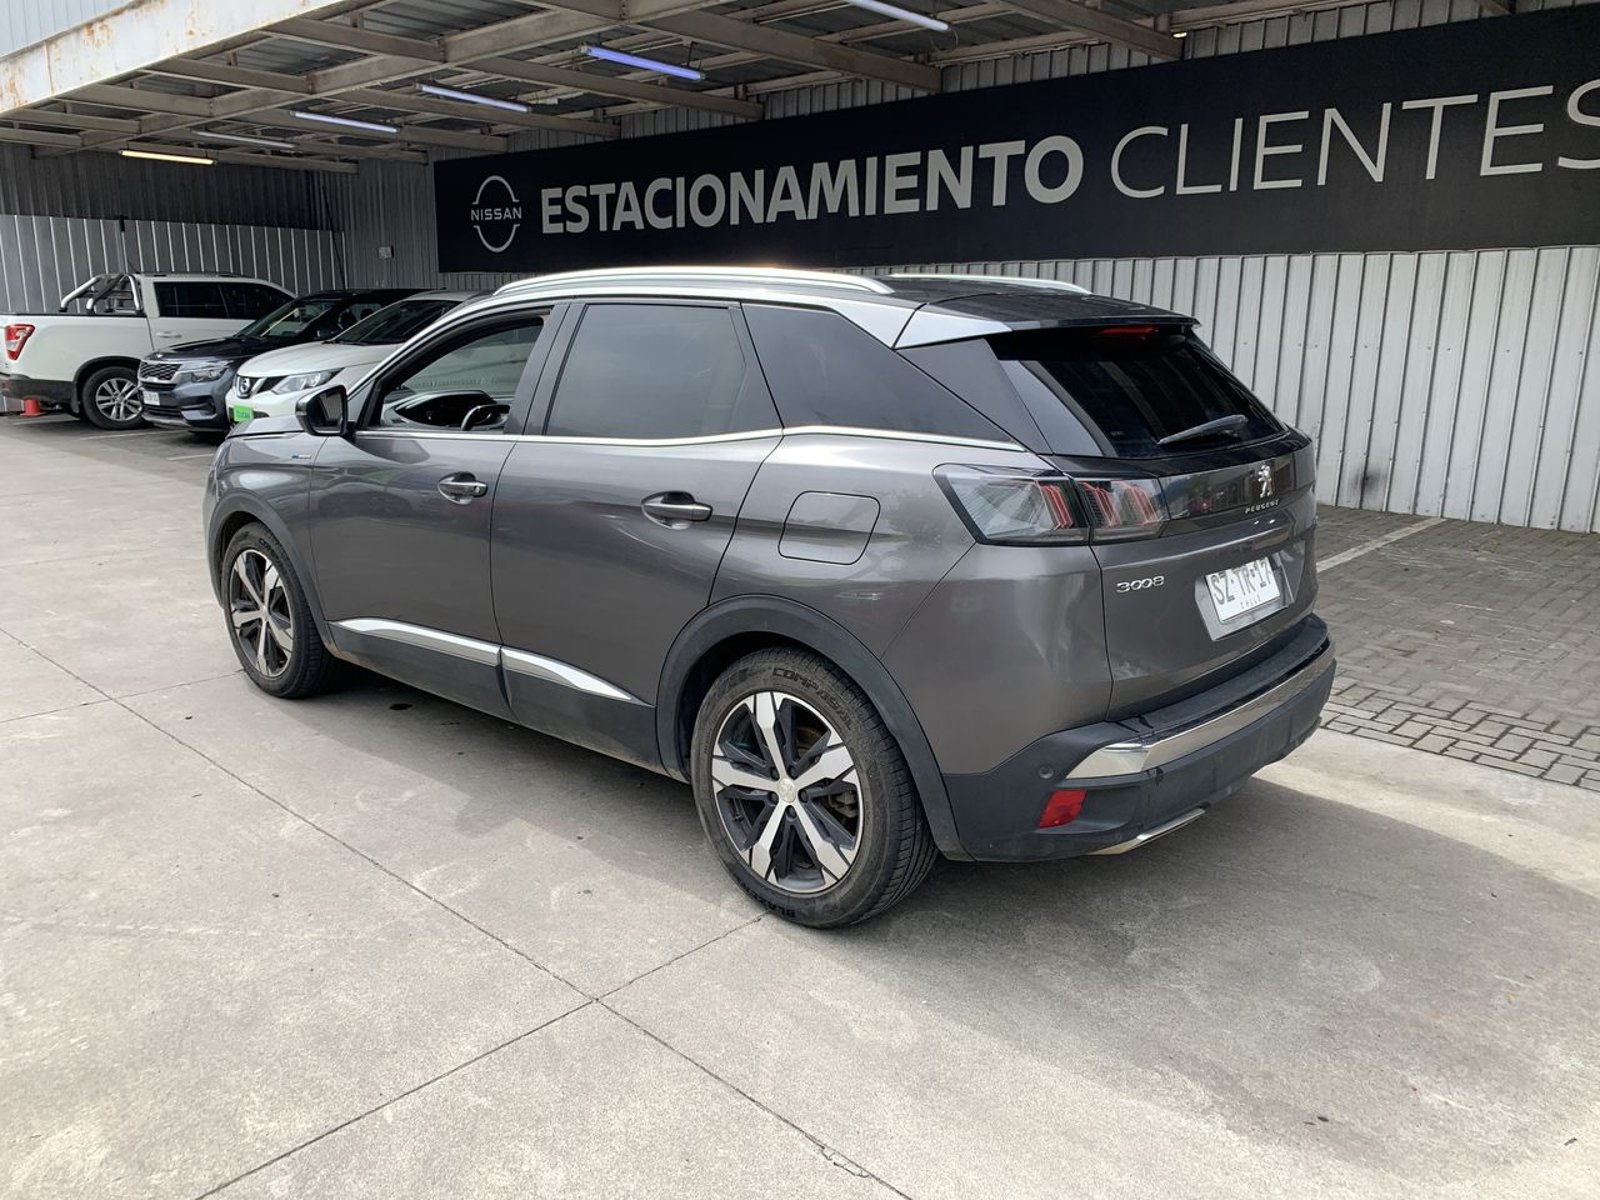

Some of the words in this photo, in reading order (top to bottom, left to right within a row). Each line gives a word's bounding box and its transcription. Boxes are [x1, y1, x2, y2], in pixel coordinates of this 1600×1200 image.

[541, 135, 1084, 234] ESTACIONAMIENTO
[1111, 78, 1600, 198] CLIENTES
[470, 207, 522, 222] NISSAN
[1116, 575, 1165, 593] 3008
